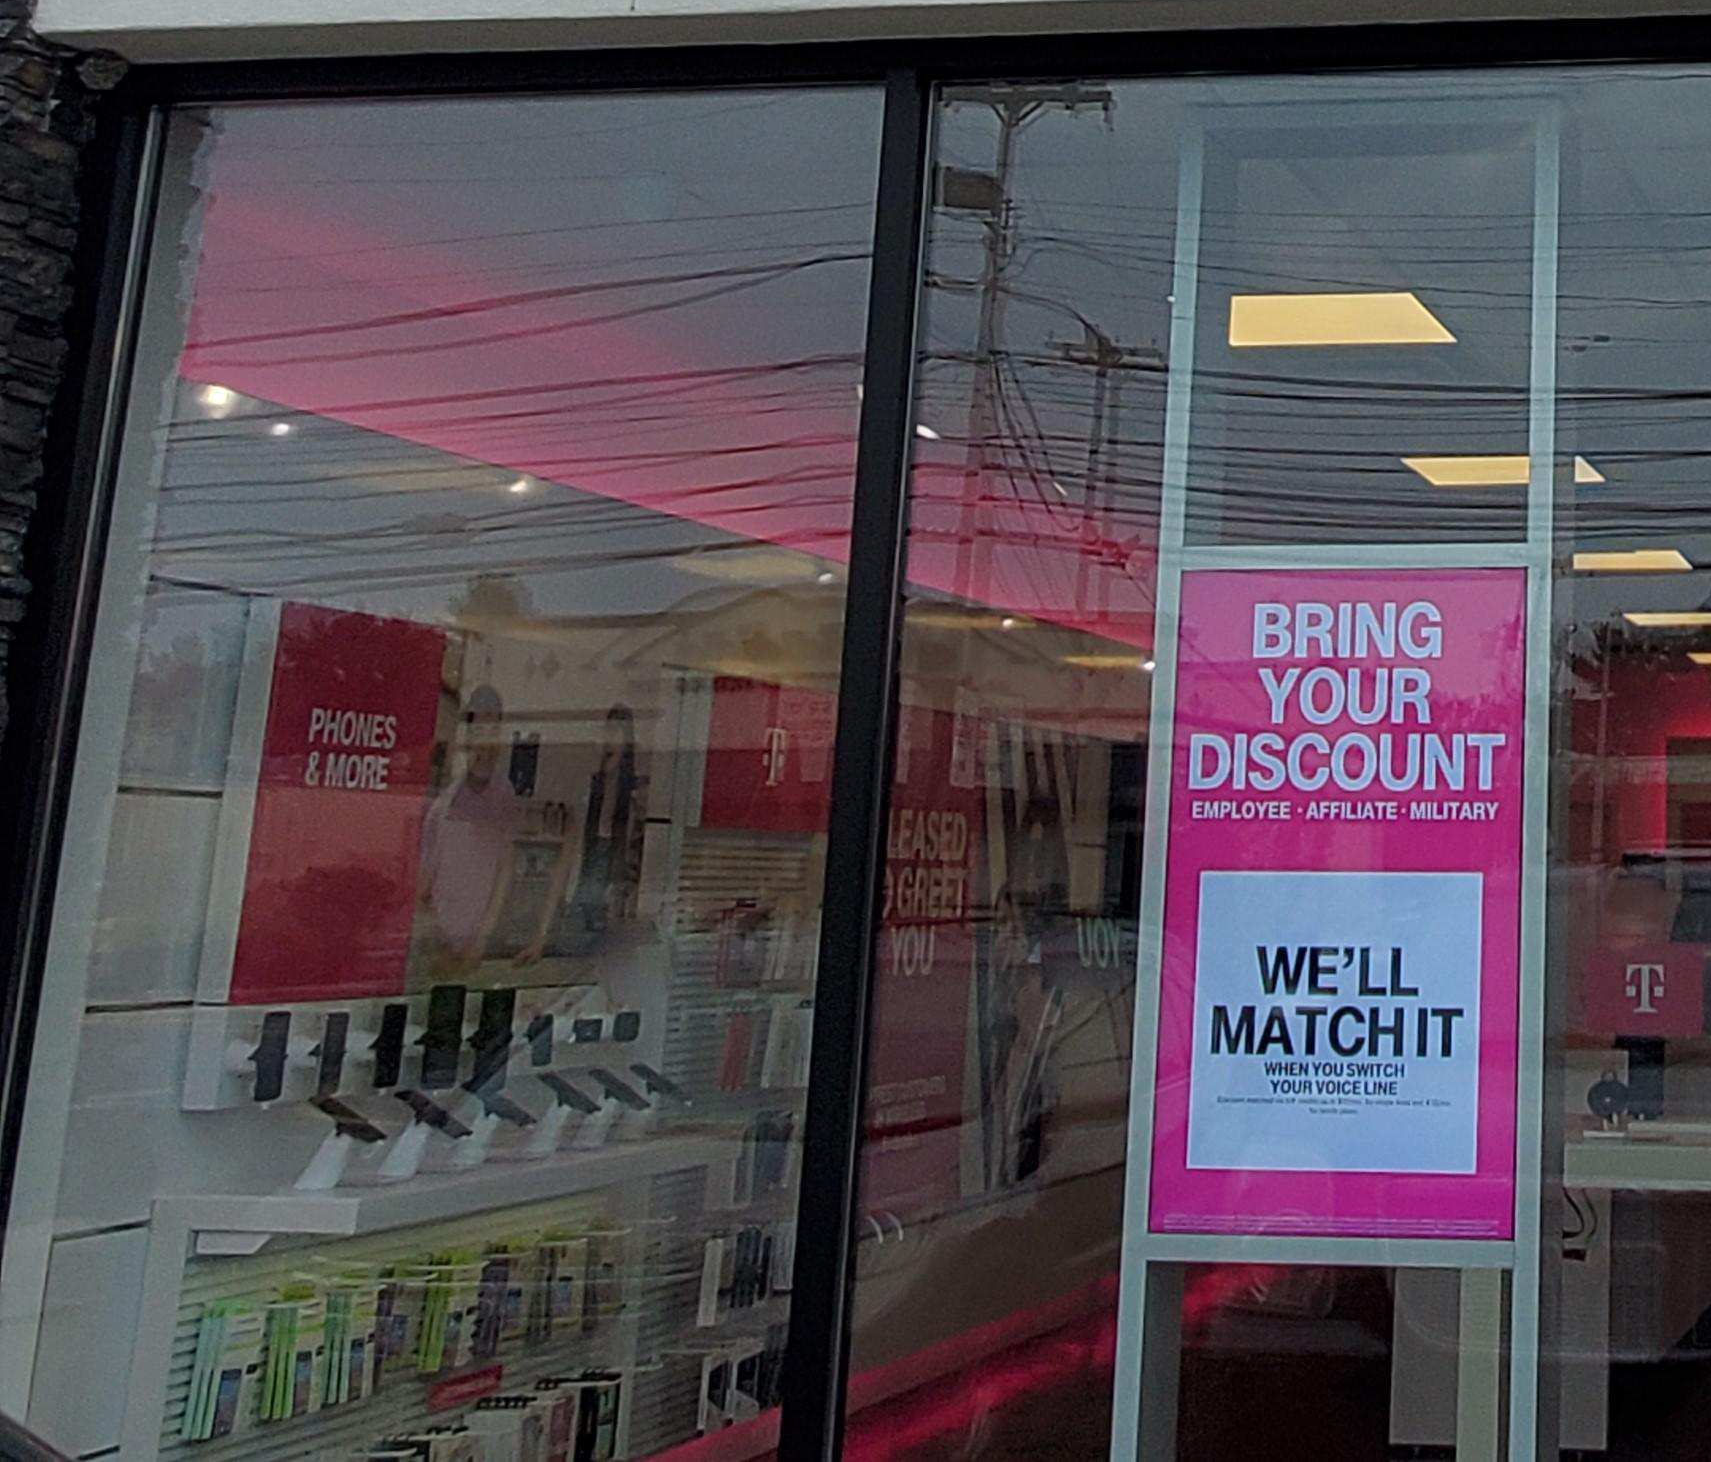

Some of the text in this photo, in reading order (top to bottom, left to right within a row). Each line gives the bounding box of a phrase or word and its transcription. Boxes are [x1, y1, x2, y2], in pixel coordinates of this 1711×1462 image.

[1252, 601, 1442, 659] BRING
[1257, 666, 1432, 725] YOUR
[308, 707, 397, 750] PHONES
[304, 750, 391, 791] & MORE
[1188, 731, 1506, 792] DISCOUNT
[1191, 800, 1499, 821] EMPLOYEE AFFILIATE MILITARY
[890, 925, 936, 977] YOU
[1256, 945, 1420, 997] WE'LL
[1210, 1005, 1465, 1058] MATCH IT
[1264, 1061, 1405, 1078] WHEN YOU SWITCH
[1269, 1079, 1398, 1096] YOUR VOICE LINE
